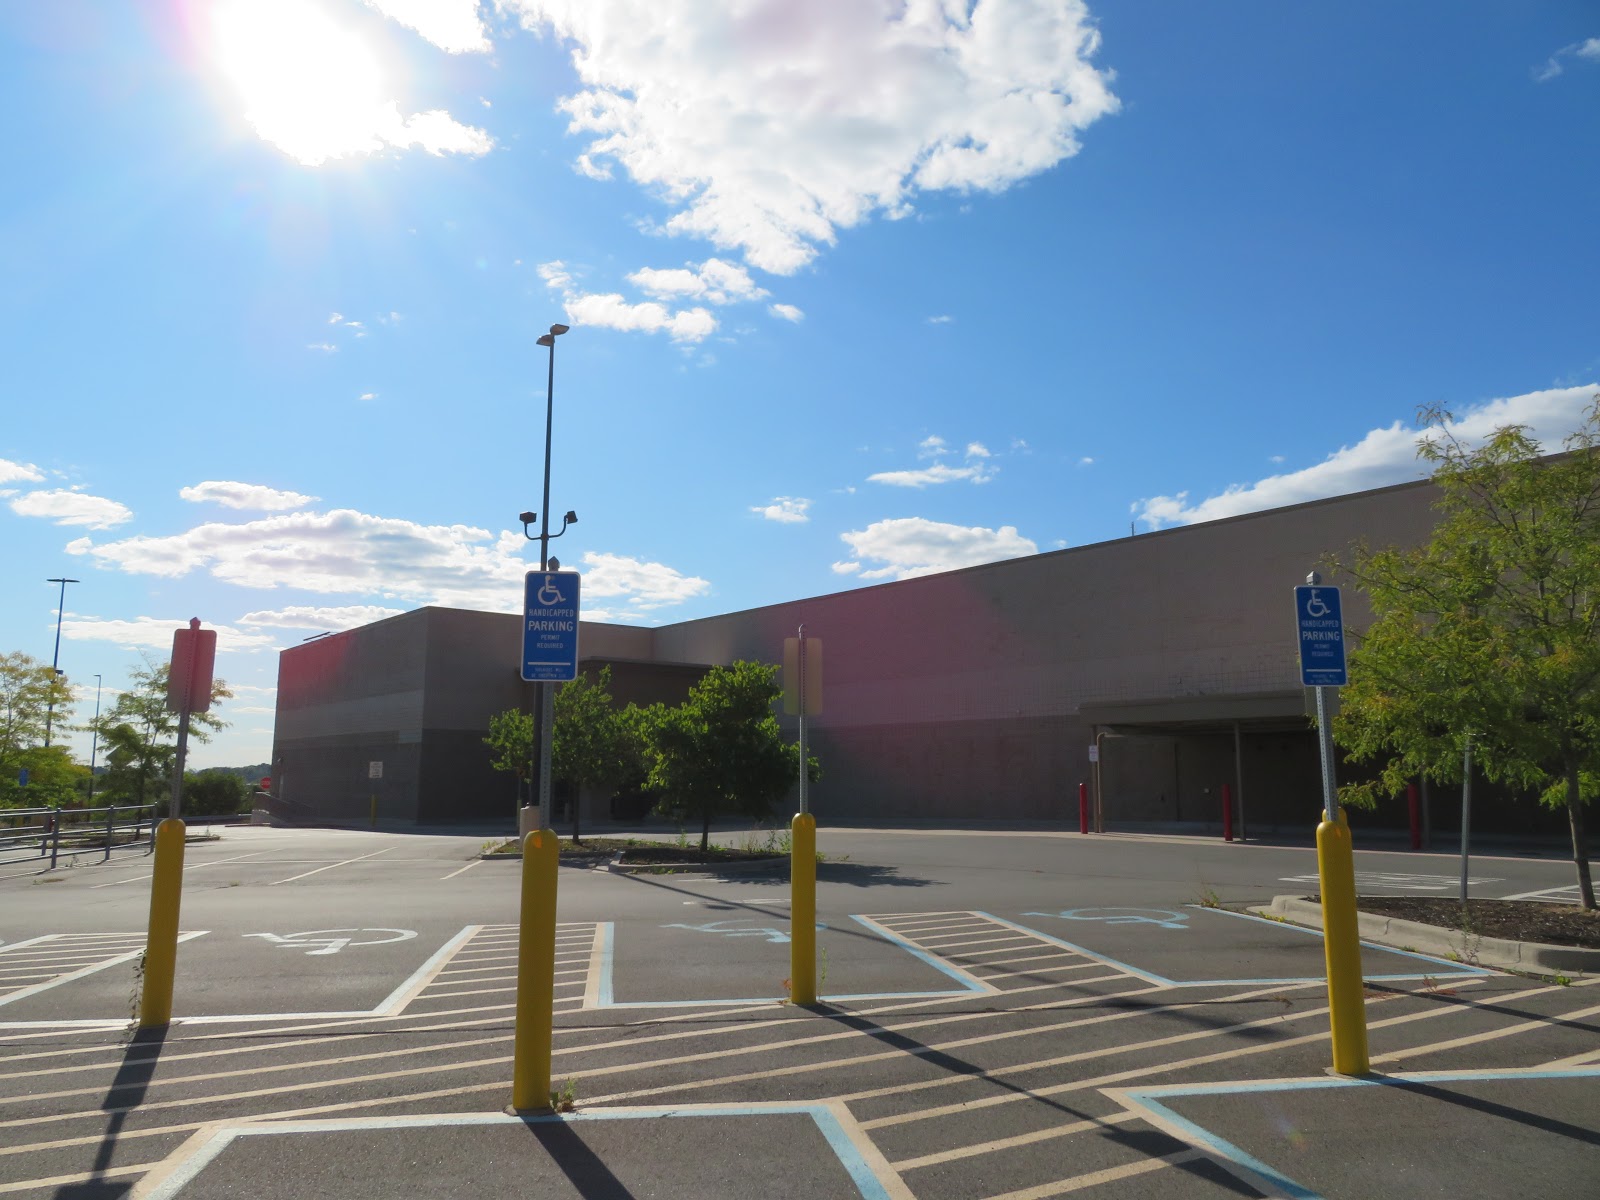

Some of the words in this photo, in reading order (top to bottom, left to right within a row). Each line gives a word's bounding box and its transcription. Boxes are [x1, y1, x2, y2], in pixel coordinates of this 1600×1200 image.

[529, 608, 574, 617] HANDICAPPED
[528, 620, 573, 632] PARKING
[1302, 620, 1338, 628] HANDICAPPED
[1302, 631, 1340, 640] PARKING
